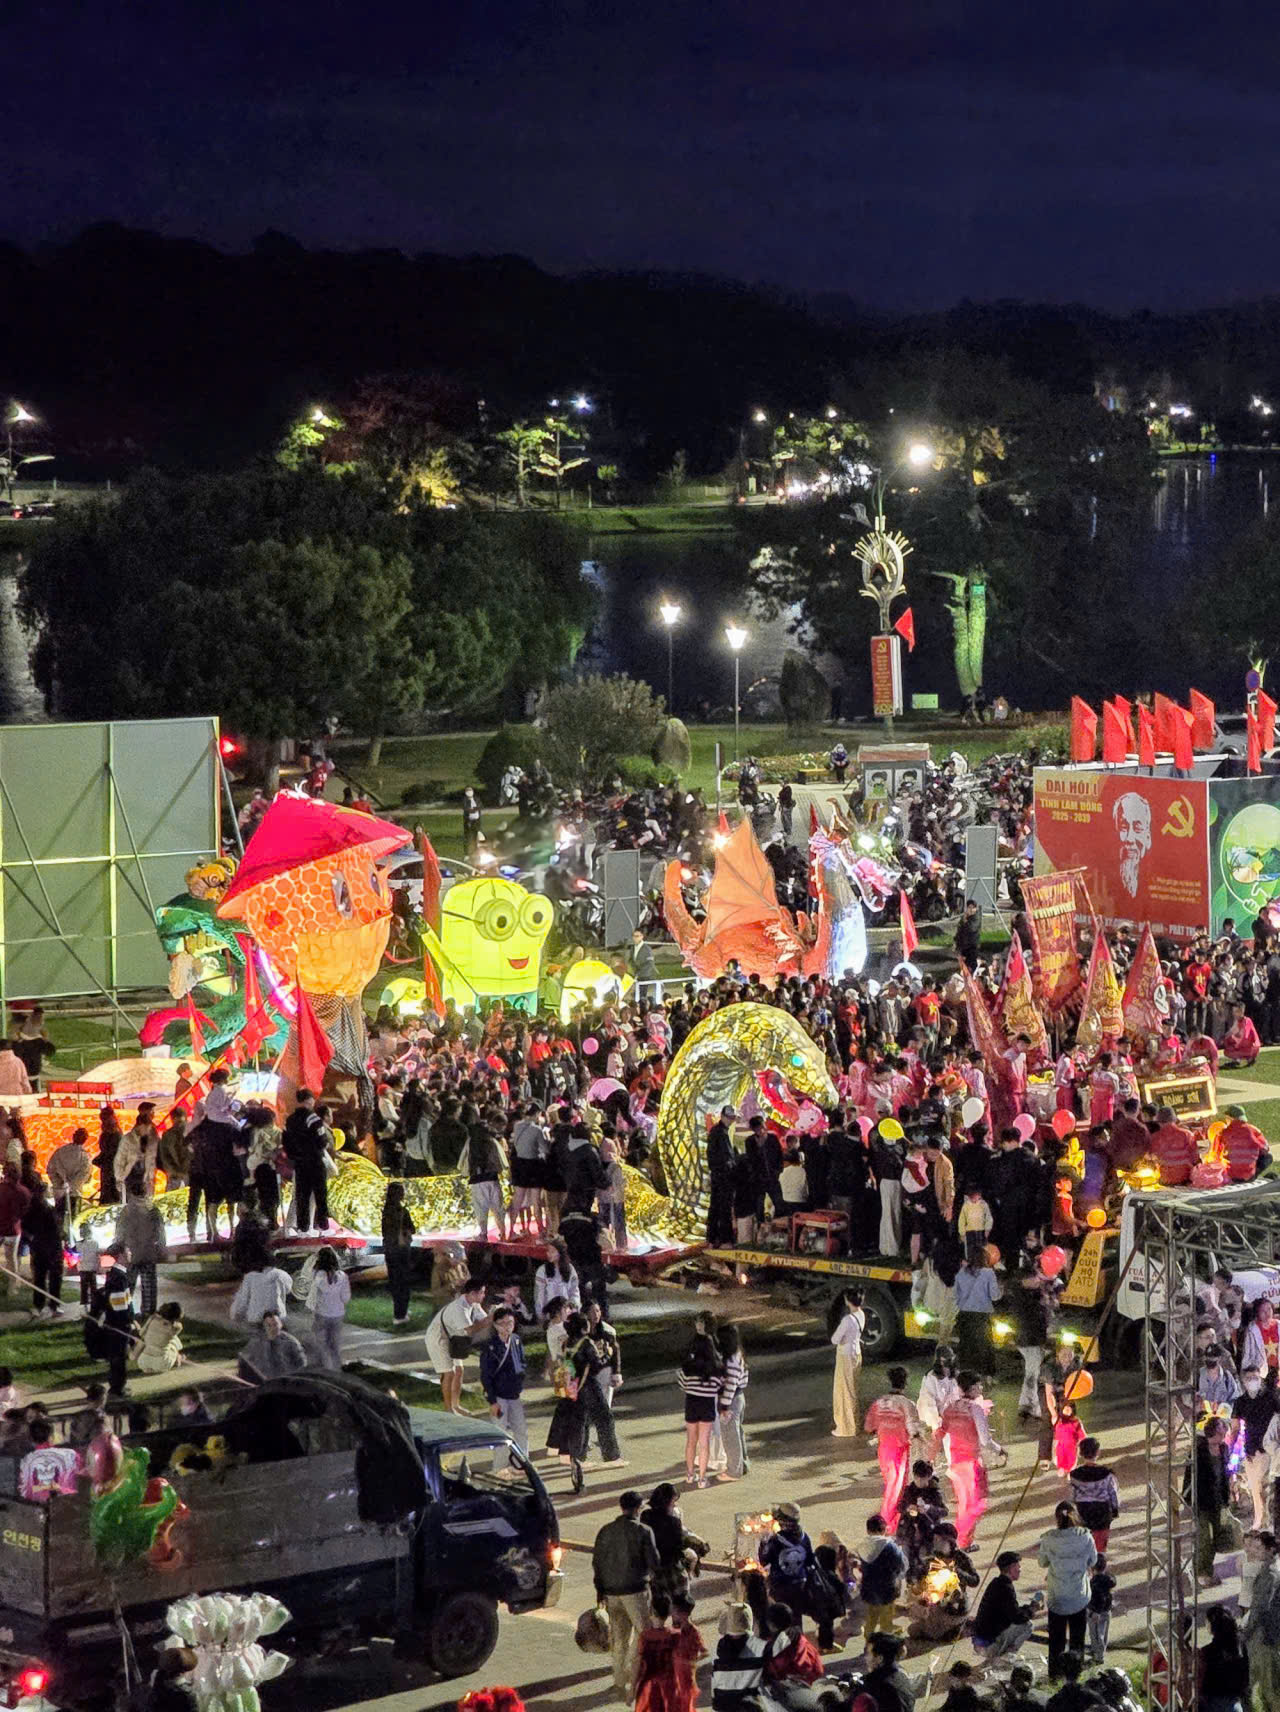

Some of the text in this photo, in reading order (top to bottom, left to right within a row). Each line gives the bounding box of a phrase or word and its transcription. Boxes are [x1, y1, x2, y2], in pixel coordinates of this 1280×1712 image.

[735, 1251, 757, 1262] KIA
[1083, 1249, 1098, 1257] 24h
[1261, 1286, 1280, 1299] CỨU
